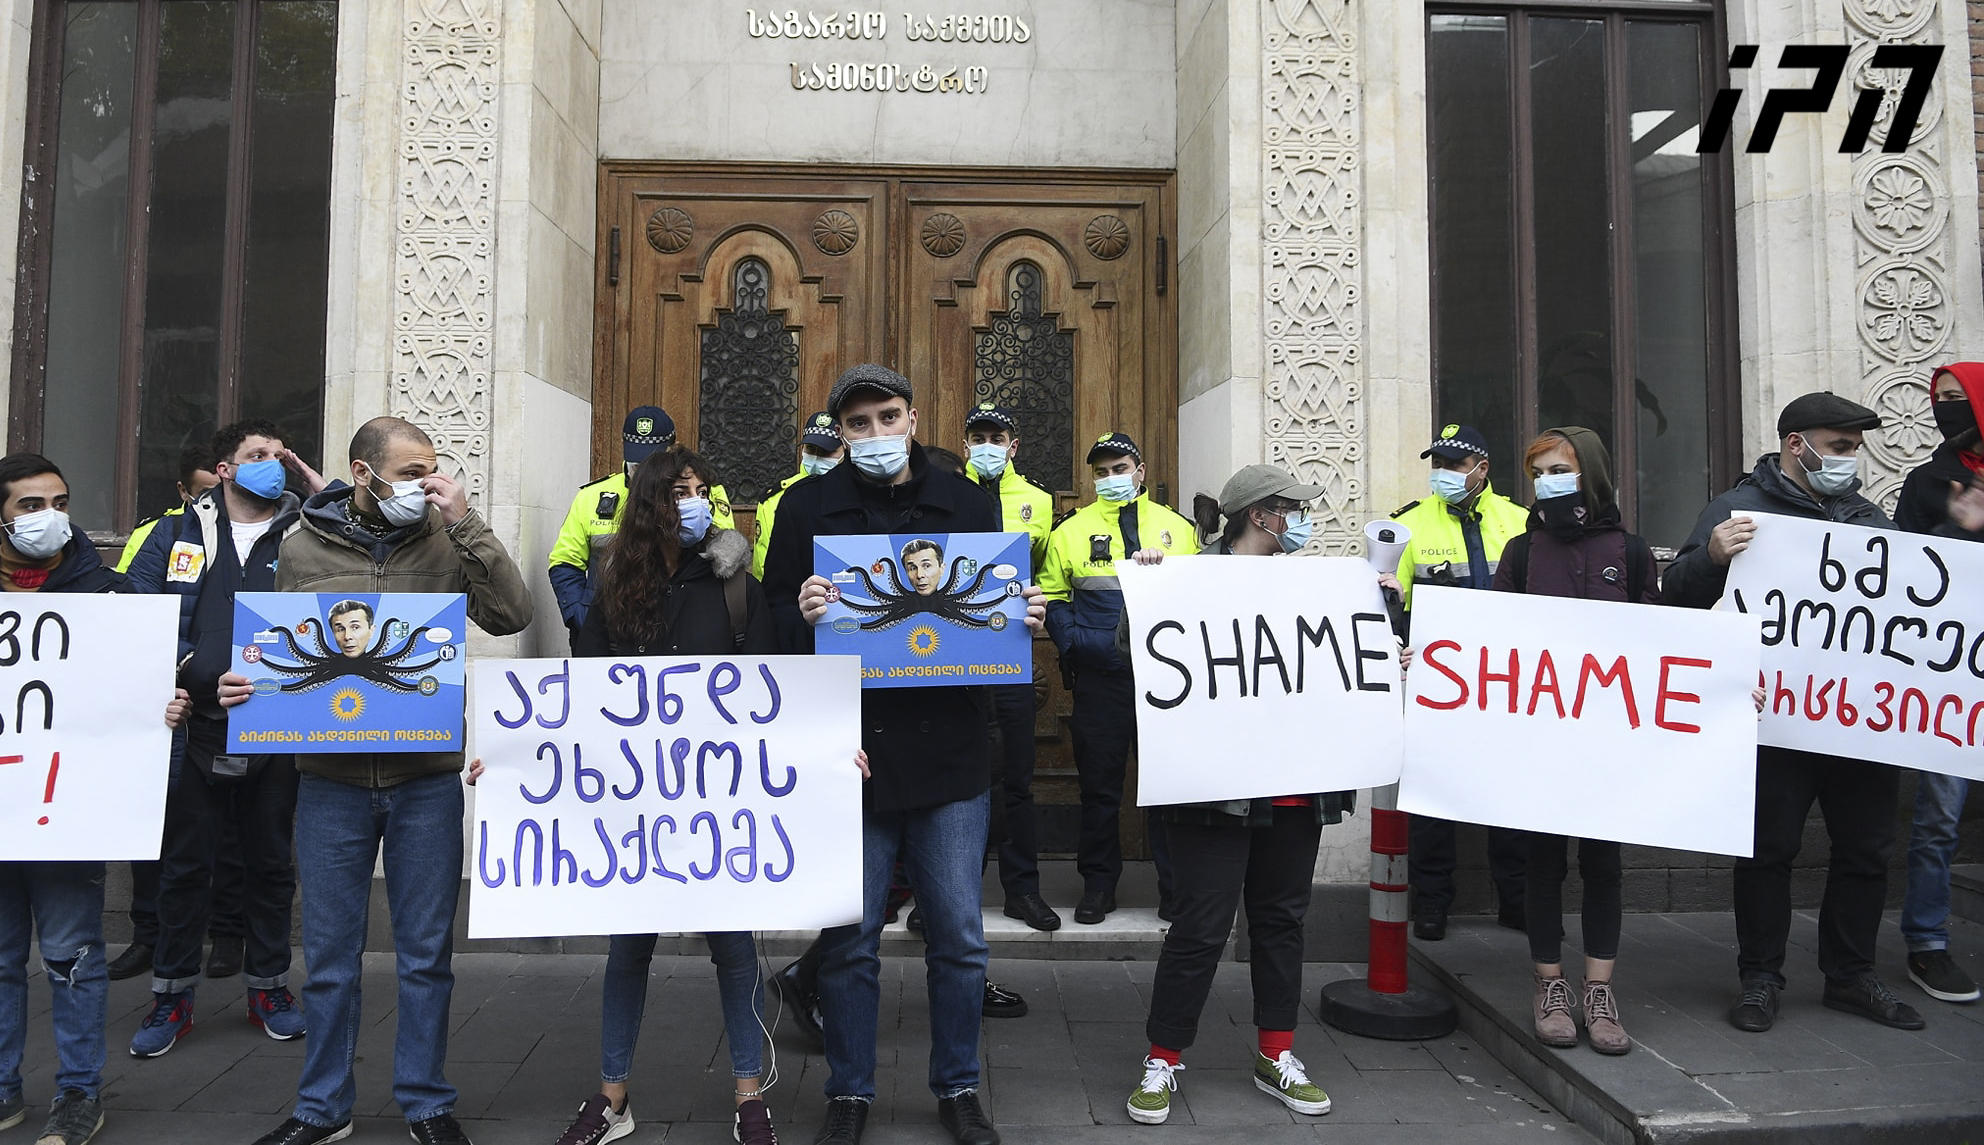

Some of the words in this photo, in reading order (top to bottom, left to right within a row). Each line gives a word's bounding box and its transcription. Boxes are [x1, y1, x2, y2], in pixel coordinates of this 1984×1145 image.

[746, 8, 887, 39] საგარეო
[903, 12, 1032, 43] საქმეთა
[789, 61, 989, 94] სამინისტრო
[1421, 547, 1457, 556] POLICE
[1819, 532, 1950, 608] ხმა
[493, 659, 571, 729] აქ
[600, 661, 782, 727] უნდა
[888, 664, 965, 678] ახდენილი
[968, 663, 1022, 676] ოცნება
[1145, 612, 1391, 710] SHAME
[1415, 639, 1713, 734] SHAME
[239, 730, 303, 742] ბიძინას
[308, 730, 390, 742] ახდენილი
[394, 729, 452, 741] ოცნება
[519, 737, 797, 805] ეხატოს
[479, 808, 795, 889] სირაქლემა
